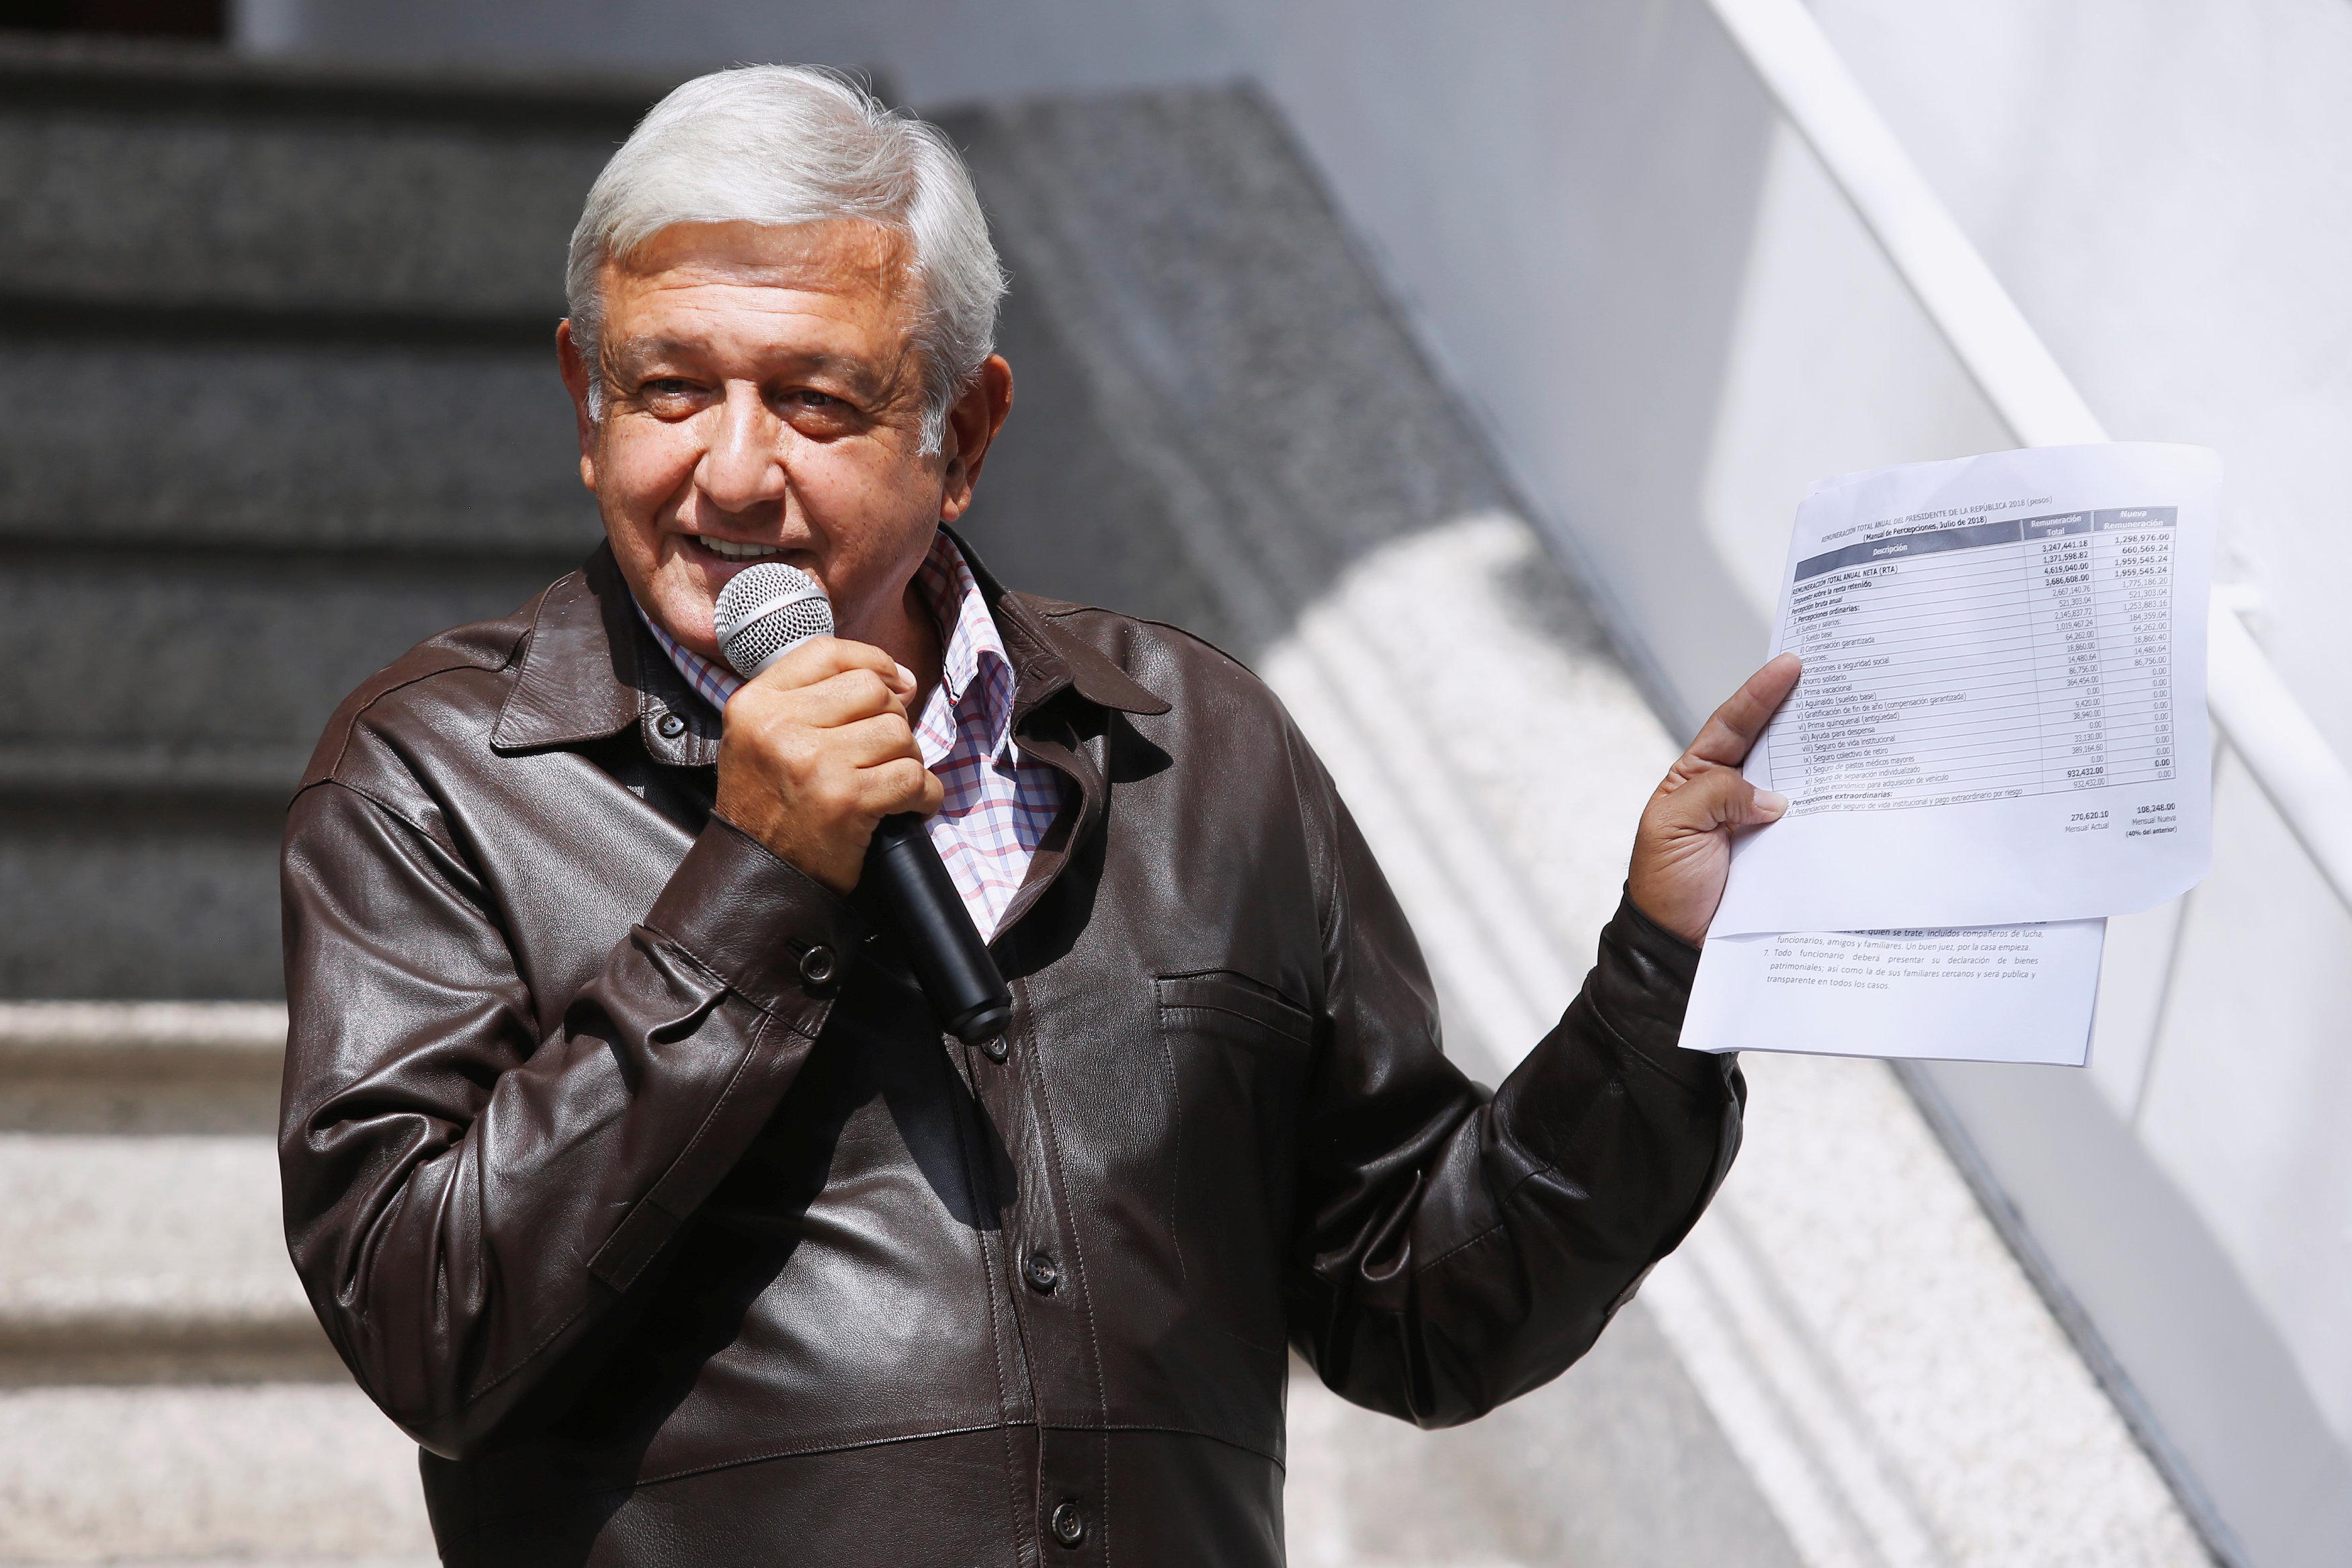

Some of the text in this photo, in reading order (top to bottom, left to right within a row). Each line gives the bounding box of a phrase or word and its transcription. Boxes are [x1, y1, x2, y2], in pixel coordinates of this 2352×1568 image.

[1820, 527, 1856, 543] REMUNERACIÓN
[1857, 523, 1874, 531] TOTAL
[1874, 519, 1892, 529] ANUAL
[1893, 517, 1904, 525] DEL
[1904, 510, 1947, 522] PRESIDENTE
[1948, 508, 1958, 516] DE
[1970, 501, 2007, 513] REPÚBLICA
[2009, 498, 2025, 508] 2018
[2026, 495, 2052, 507] (pesos)
[2031, 515, 2081, 527] Remuneración
[2104, 520, 2163, 529] Remuneración
[1862, 530, 1885, 541] (Manual
[1892, 523, 1938, 537] Percepciones,
[1939, 520, 1956, 529] Julio
[1967, 515, 1987, 525] 2018)
[2047, 527, 2066, 536] Total
[2115, 533, 2169, 546] 1,298,976.00
[1873, 543, 1908, 556] Descripción
[2042, 539, 2088, 554] 3,247,441.18
[2122, 544, 2168, 555] 660,569.24
[2044, 551, 2088, 565] 1,371,598.82
[2115, 555, 2167, 567] 1,959,545.24
[2044, 562, 2089, 575] 4,619,040.00
[2115, 566, 2167, 579] 1,959,545.24
[1792, 565, 1898, 595] REMUNERACIÓN TOTAL ANUAL NETA (RTA)
[2046, 573, 2089, 586] 3,686,608.00
[2122, 576, 2168, 589] 1,775,186.20
[1793, 593, 1813, 607] Impuesto
[1812, 590, 1826, 600] sobre
[1833, 585, 1846, 593] renta
[1847, 580, 1872, 589] retenido
[2052, 584, 2091, 598] 2,667,140.76
[2128, 588, 2167, 600] 521,303.04
[1791, 595, 1843, 615] Percepción bruta anual
[2059, 596, 2093, 607] 521,303.04
[2124, 599, 2167, 612] 1,253,883.16
[1796, 605, 1859, 625] Percepciones ordinarias:
[2054, 607, 2093, 619] 2,145,837.72
[2130, 610, 2167, 622] 184,359.04
[2056, 619, 2093, 631] 1,019,467.24
[2133, 621, 2168, 633] 64,262.00
[2065, 629, 2095, 641] 64,262.00
[2134, 633, 2167, 645] 18,860.40
[2067, 641, 2095, 653] 18,860.00
[2134, 644, 2167, 656] 14,480.64
[2068, 652, 2097, 664] 14,480.64
[2134, 655, 2168, 667] 86,756.00
[2068, 664, 2099, 675] 86,756.00
[2152, 666, 2167, 675] 0.00
[2066, 675, 2100, 687] 364,454.00
[2153, 678, 2167, 687] 0.00
[1804, 683, 1852, 696] Prima vacacional
[2087, 686, 2100, 695] 0.00
[2153, 689, 2167, 698] 0.00
[1804, 692, 1877, 708] Aguinaldo (sueldo base)
[1804, 707, 1841, 718] Gratificación
[1861, 703, 1870, 711] de
[1871, 702, 1883, 710] año
[1884, 696, 1929, 710] (compensación
[1929, 692, 1967, 705] garantizada)
[2075, 697, 2101, 708] 9,420.00
[2154, 701, 2168, 709] 0.00
[1807, 711, 1900, 729] Prima quinquenal (antigüedad)
[2073, 709, 2102, 720] 38,940.00
[2154, 712, 2169, 721] 0.00
[2089, 720, 2102, 729] 0.00
[2155, 723, 2169, 732] 0.00
[1810, 726, 1875, 741] Ayuda para despensa
[2074, 732, 2103, 743] 33,130.00
[2155, 735, 2169, 744] 0.00
[2072, 743, 2104, 754] 389,164.60
[2156, 746, 2170, 755] 0.00
[2091, 754, 2103, 763] 0.00
[2155, 758, 2170, 767] 0.00
[2067, 766, 2103, 779] 932,432.00
[2158, 769, 2171, 778] 0.00
[2073, 777, 2105, 789] 932,432.00
[1792, 794, 1833, 806] Percepciones
[1835, 791, 1892, 799] extraordinarias:
[2137, 802, 2175, 814] 108,248.00
[2070, 810, 2109, 821] 270,620.10
[2132, 816, 2156, 825] Mensual
[2065, 821, 2109, 832] Mensual Actual
[2126, 830, 2142, 838] (40%
[2152, 826, 2177, 834] anterior)
[1904, 929, 1925, 938] trate,
[1962, 929, 2008, 939] compañeros
[2011, 929, 2020, 937] de
[2023, 929, 2044, 937] lucha,
[1777, 935, 1824, 945] funcionarios,
[1826, 939, 1855, 949] amigos
[1863, 939, 1903, 949] familiares.
[1937, 943, 1955, 952] juez,
[1972, 943, 1978, 951] la
[1998, 943, 2031, 953] empieza.
[1800, 949, 1844, 959] funcionario
[1852, 953, 1880, 961] deberá
[1888, 956, 1925, 964] presentar
[1947, 956, 1990, 964] declaración
[1997, 956, 2007, 964] de
[2014, 956, 2038, 964] bienes
[1769, 962, 1824, 972] patrimoniales;
[1876, 967, 1886, 975] de
[1903, 969, 1939, 977] familiares
[1983, 969, 1999, 977] será
[2001, 969, 2029, 979] publica
[1767, 975, 1816, 985] transparente
[1830, 979, 1852, 987] todos
[1853, 979, 1865, 988] los
